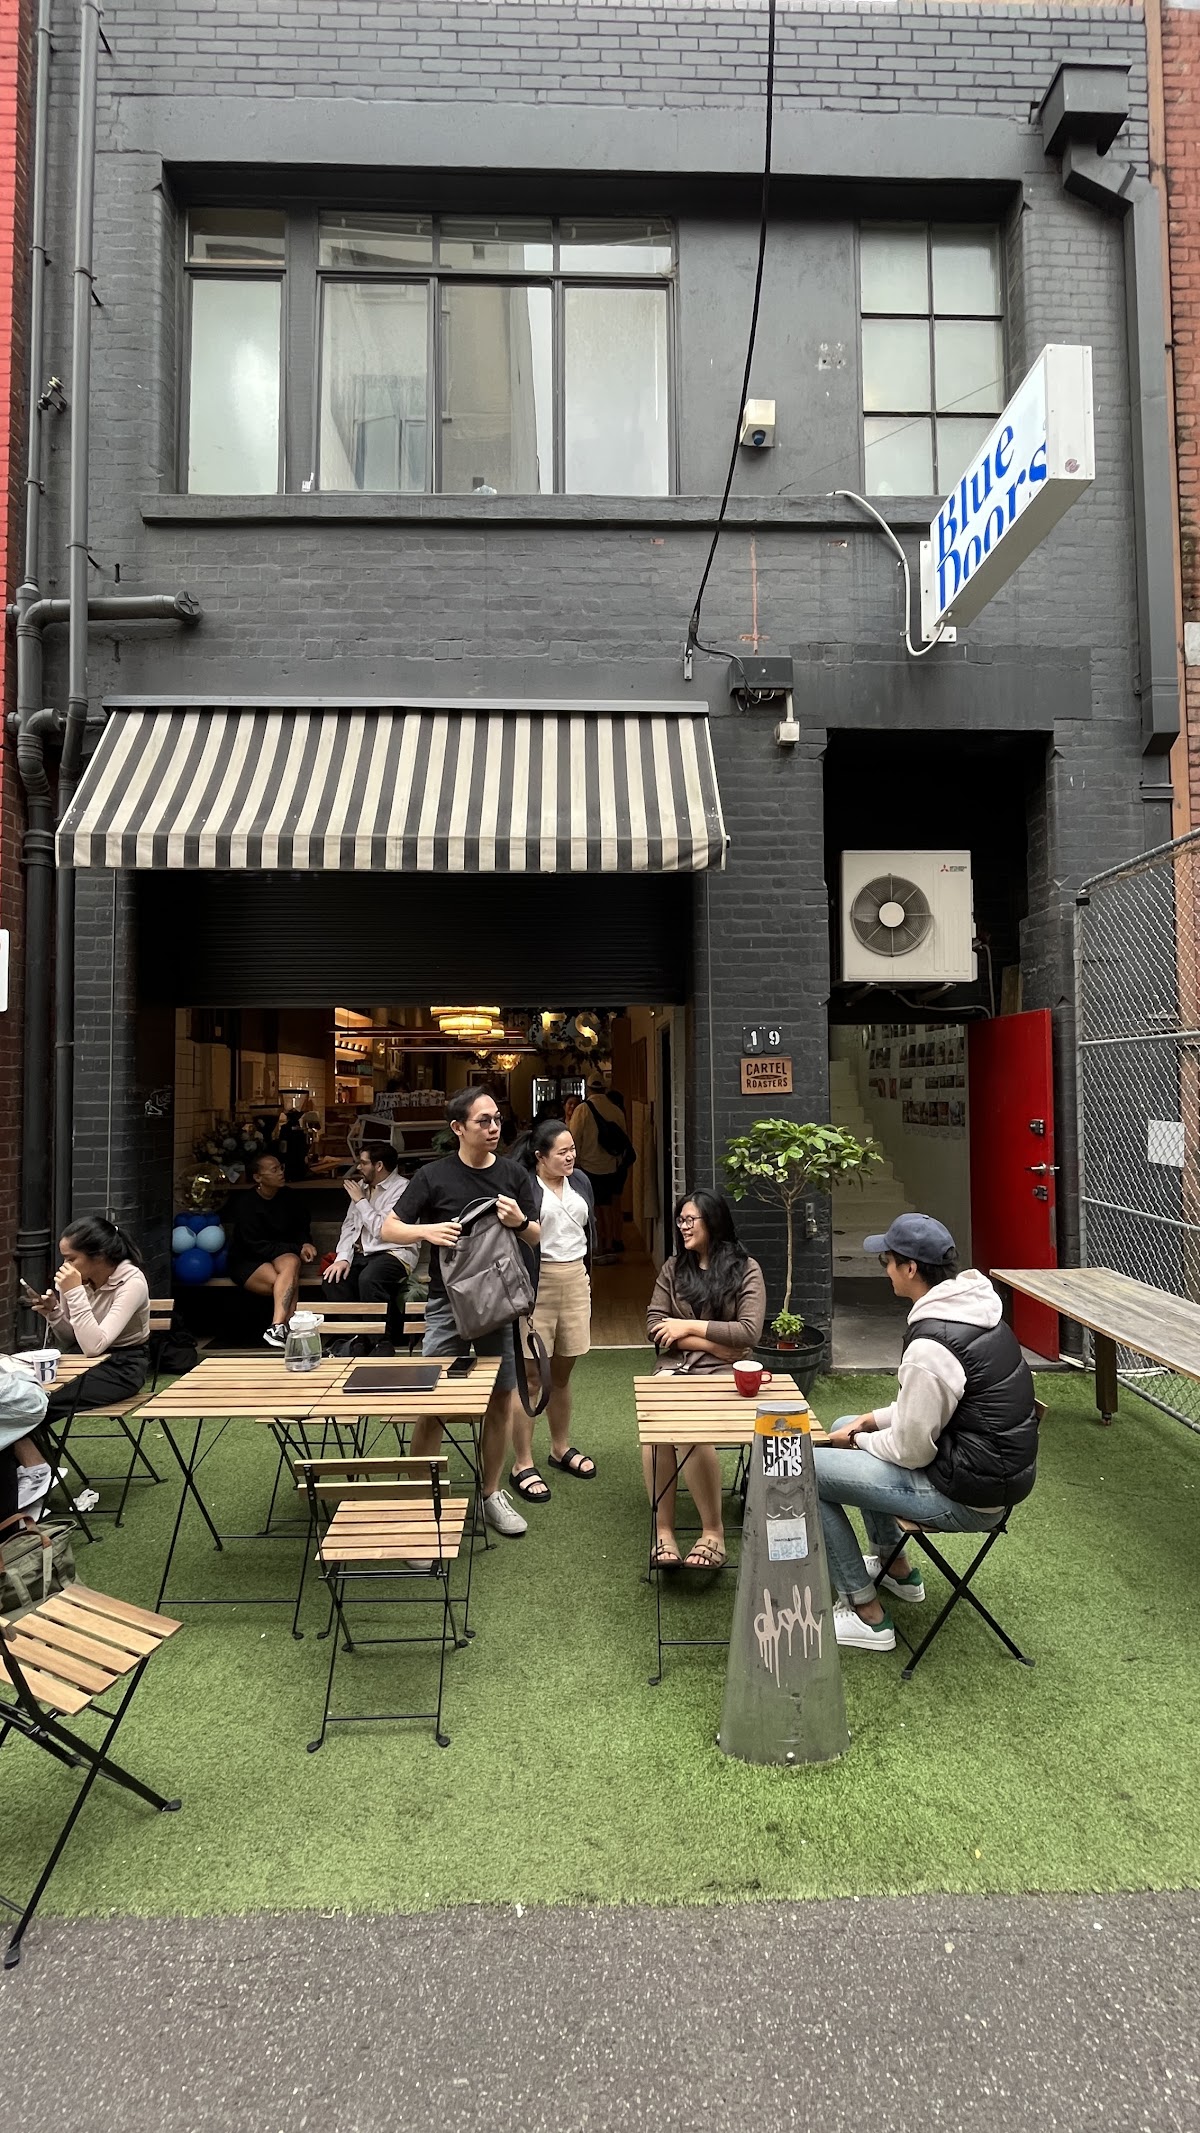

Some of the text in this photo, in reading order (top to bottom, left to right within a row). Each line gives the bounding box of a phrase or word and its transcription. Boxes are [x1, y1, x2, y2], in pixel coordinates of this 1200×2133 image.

[936, 425, 1015, 568] Blue
[936, 440, 1047, 612] Doors
[746, 1062, 788, 1076] CARTEL
[746, 1077, 788, 1089] ROASTERS
